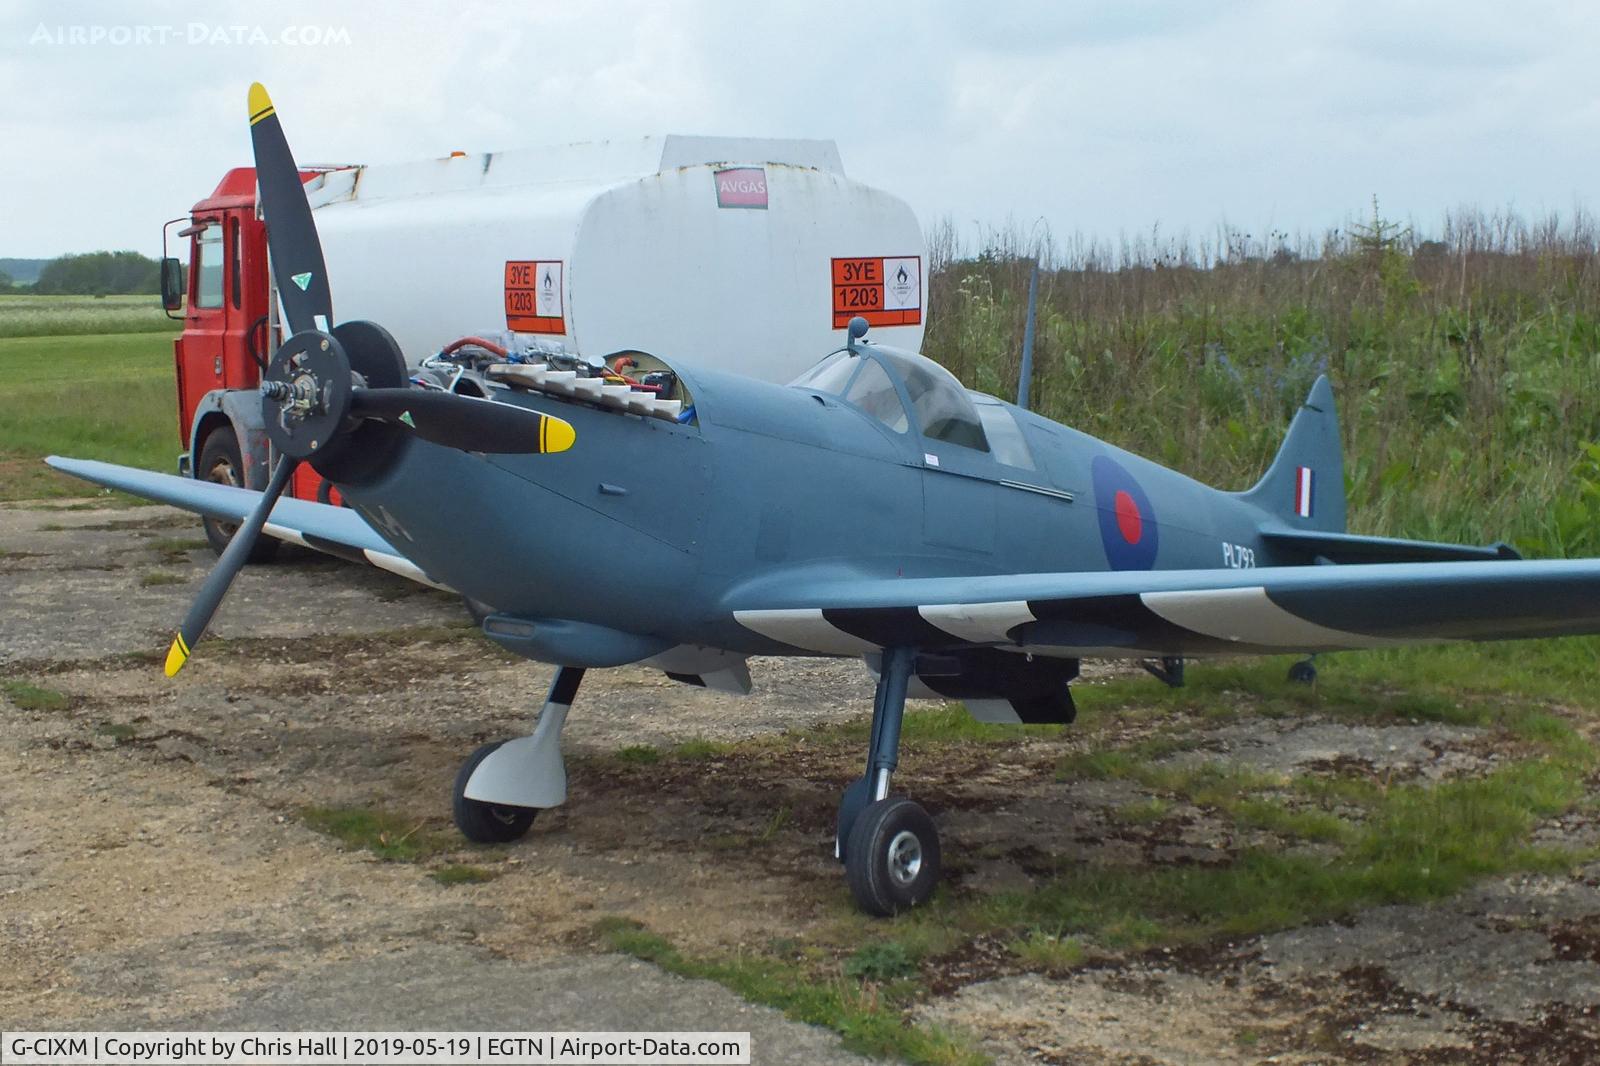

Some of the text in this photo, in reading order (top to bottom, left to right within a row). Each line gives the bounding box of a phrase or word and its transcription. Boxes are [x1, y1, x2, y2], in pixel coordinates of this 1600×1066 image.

[719, 180, 766, 194] AVGAS
[510, 265, 531, 285] 3YE
[843, 261, 876, 281] 3YE
[508, 291, 532, 311] 1203
[839, 287, 879, 307] 1203
[1221, 541, 1256, 569] PL793
